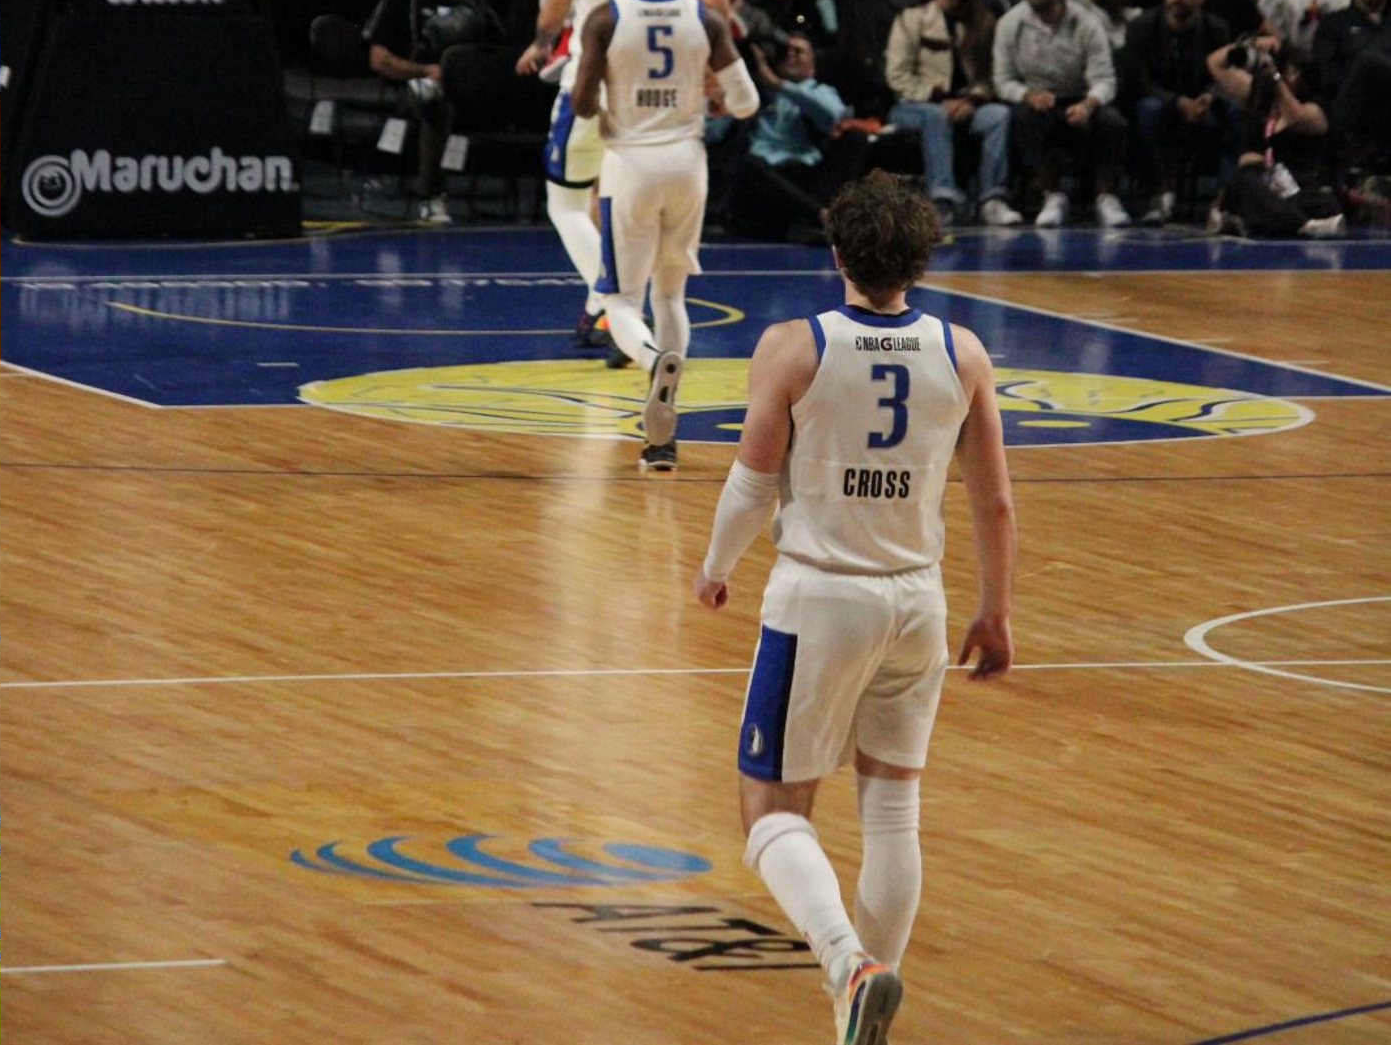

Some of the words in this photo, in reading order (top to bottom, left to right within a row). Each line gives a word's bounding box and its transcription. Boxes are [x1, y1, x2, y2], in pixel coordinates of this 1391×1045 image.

[647, 25, 674, 80] 5
[69, 146, 293, 194] Maruchan
[863, 336, 880, 352] NBA
[893, 336, 921, 352] LEAGUE
[867, 364, 910, 449] 3
[843, 468, 911, 499] CROSS
